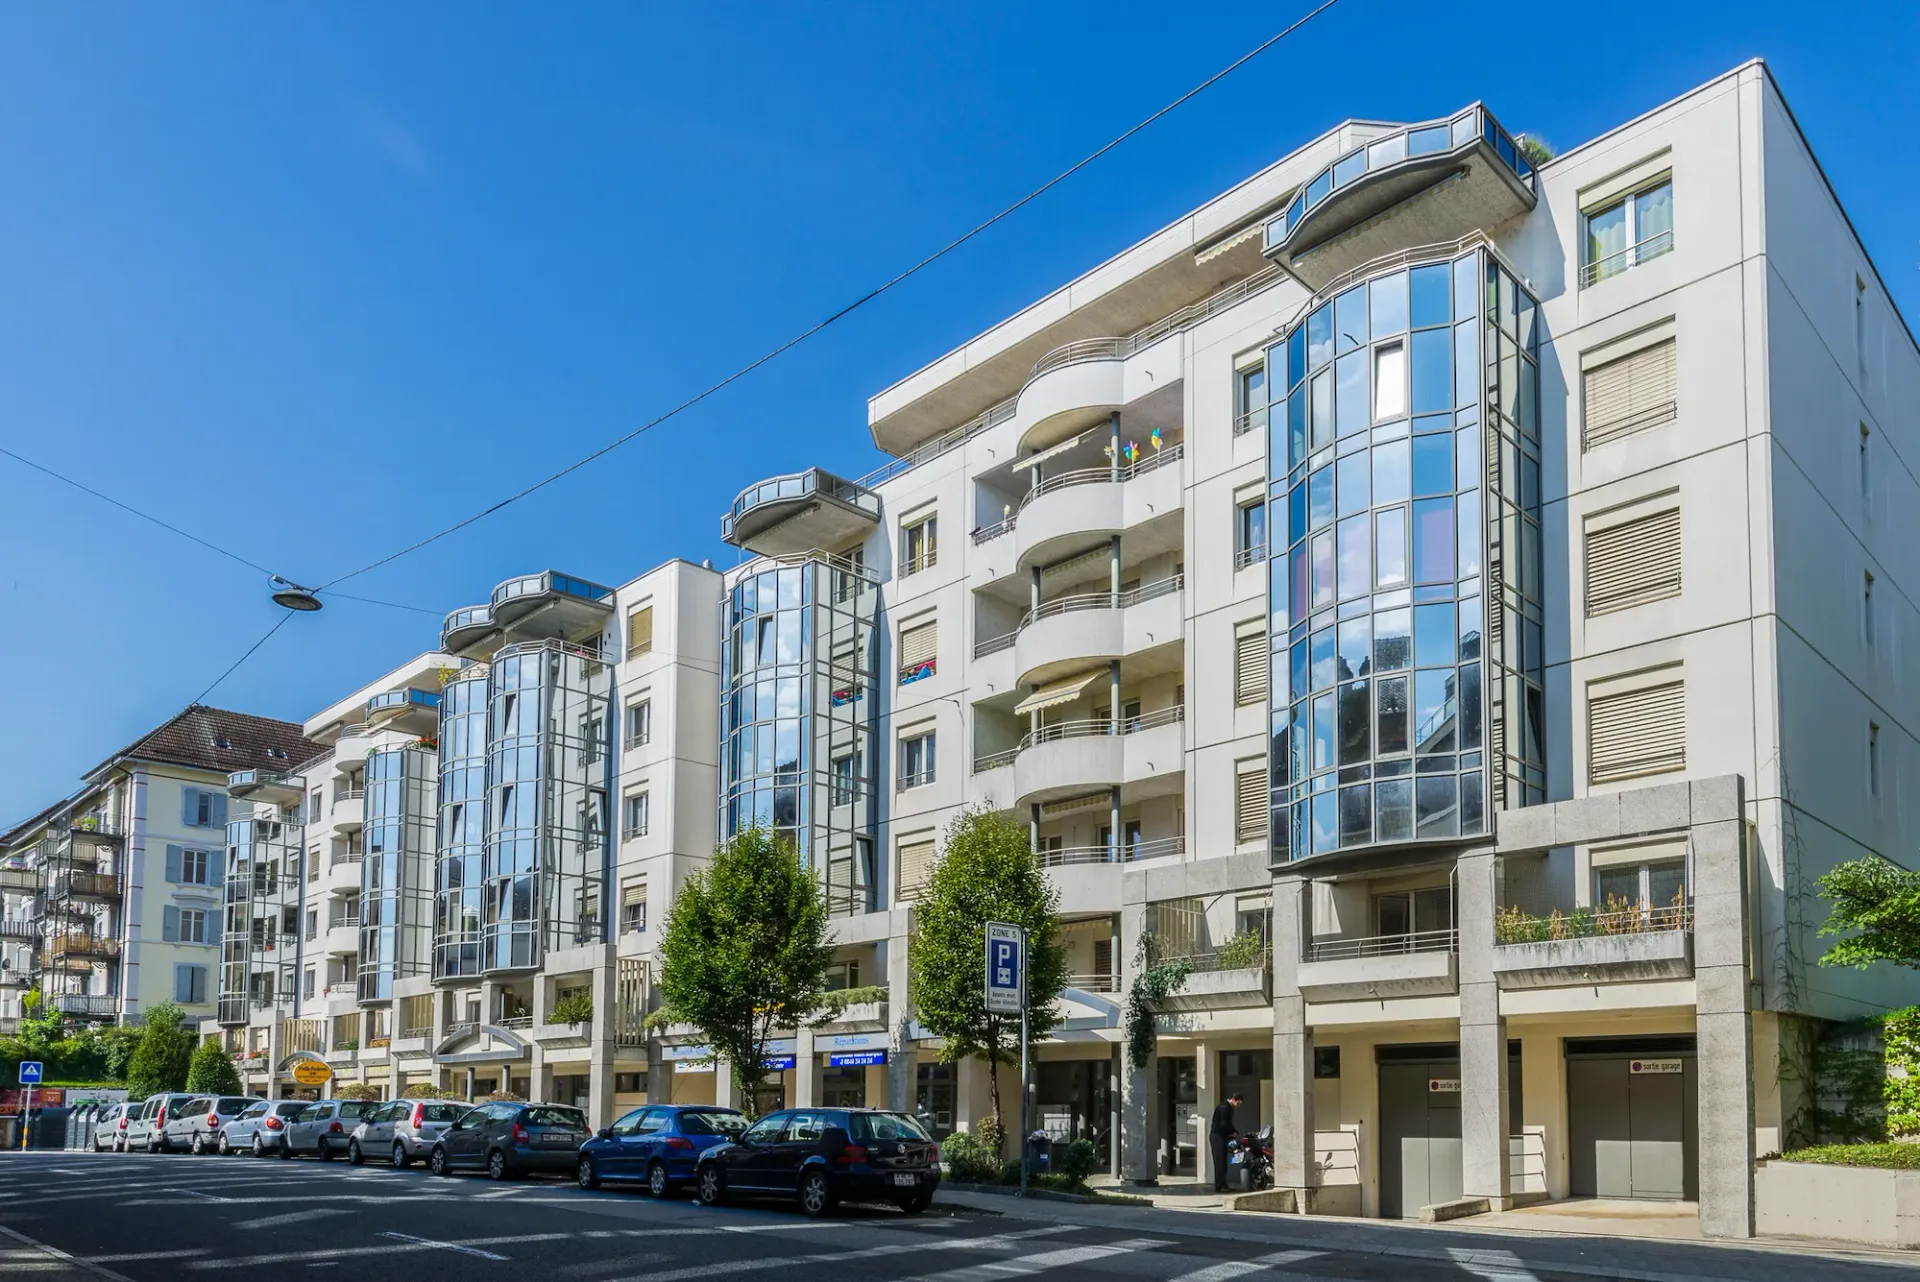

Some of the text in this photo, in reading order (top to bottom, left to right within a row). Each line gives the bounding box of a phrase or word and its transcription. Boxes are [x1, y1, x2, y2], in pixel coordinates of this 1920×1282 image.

[992, 927, 1018, 939] ZONE 5
[998, 944, 1011, 967] P
[1643, 1061, 1681, 1071] sortie garage
